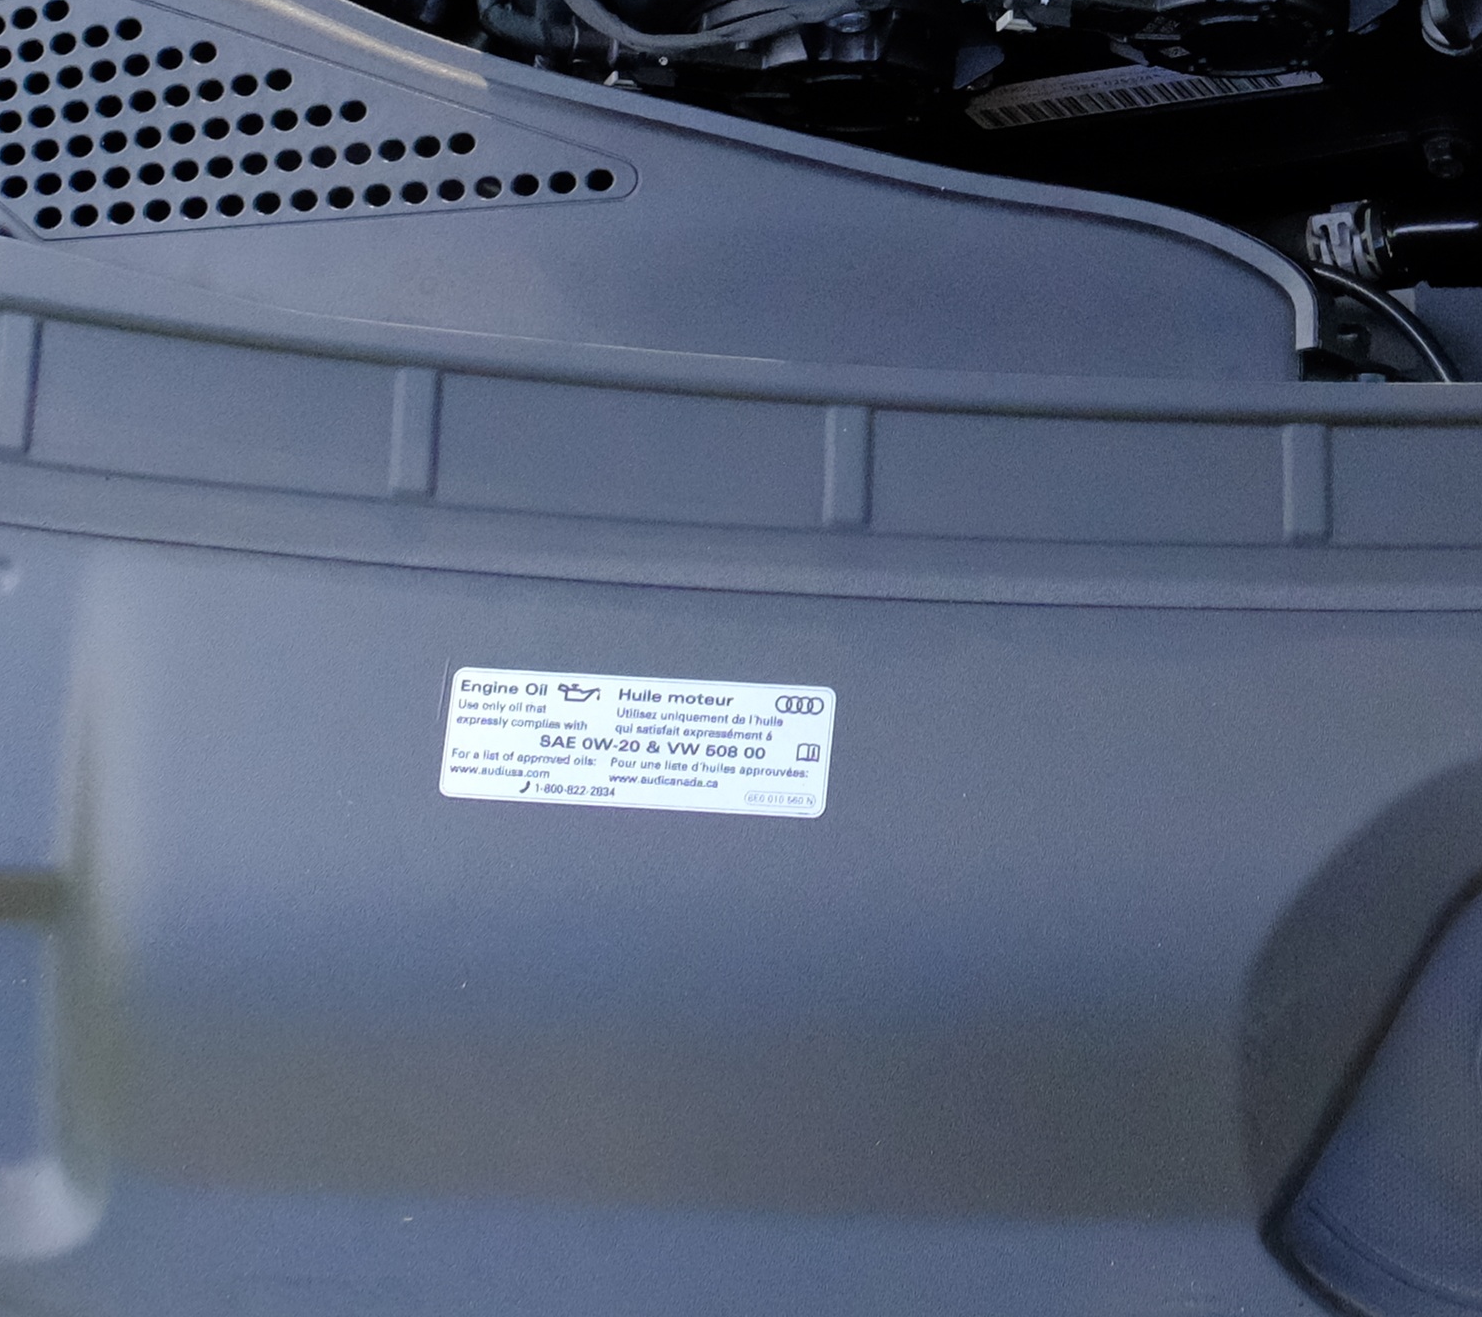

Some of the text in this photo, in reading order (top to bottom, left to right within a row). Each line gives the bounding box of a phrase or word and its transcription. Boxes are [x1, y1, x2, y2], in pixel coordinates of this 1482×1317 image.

[460, 679, 548, 696] Engine Oil
[618, 688, 733, 707] Huile moteur
[458, 699, 547, 714] Use only oil that
[456, 716, 588, 731] expressly complies with
[616, 707, 657, 720] Utilisez
[660, 712, 729, 724] uniquement
[731, 714, 746, 725] de
[614, 724, 633, 735] qui
[636, 725, 680, 736] satisfait
[683, 728, 763, 740] expressément
[540, 734, 576, 749] SAE
[582, 737, 641, 753] 0W-20
[646, 740, 661, 754] &
[667, 741, 700, 756] VW
[743, 746, 766, 760] 00
[451, 747, 597, 766] For a list of approved oils:
[450, 765, 550, 778] www.audiusa.com
[610, 756, 637, 769] Pour
[640, 761, 662, 770] une
[664, 761, 688, 772] liste
[739, 766, 809, 778] approuvées:
[609, 775, 718, 788] www.audicanada.ca
